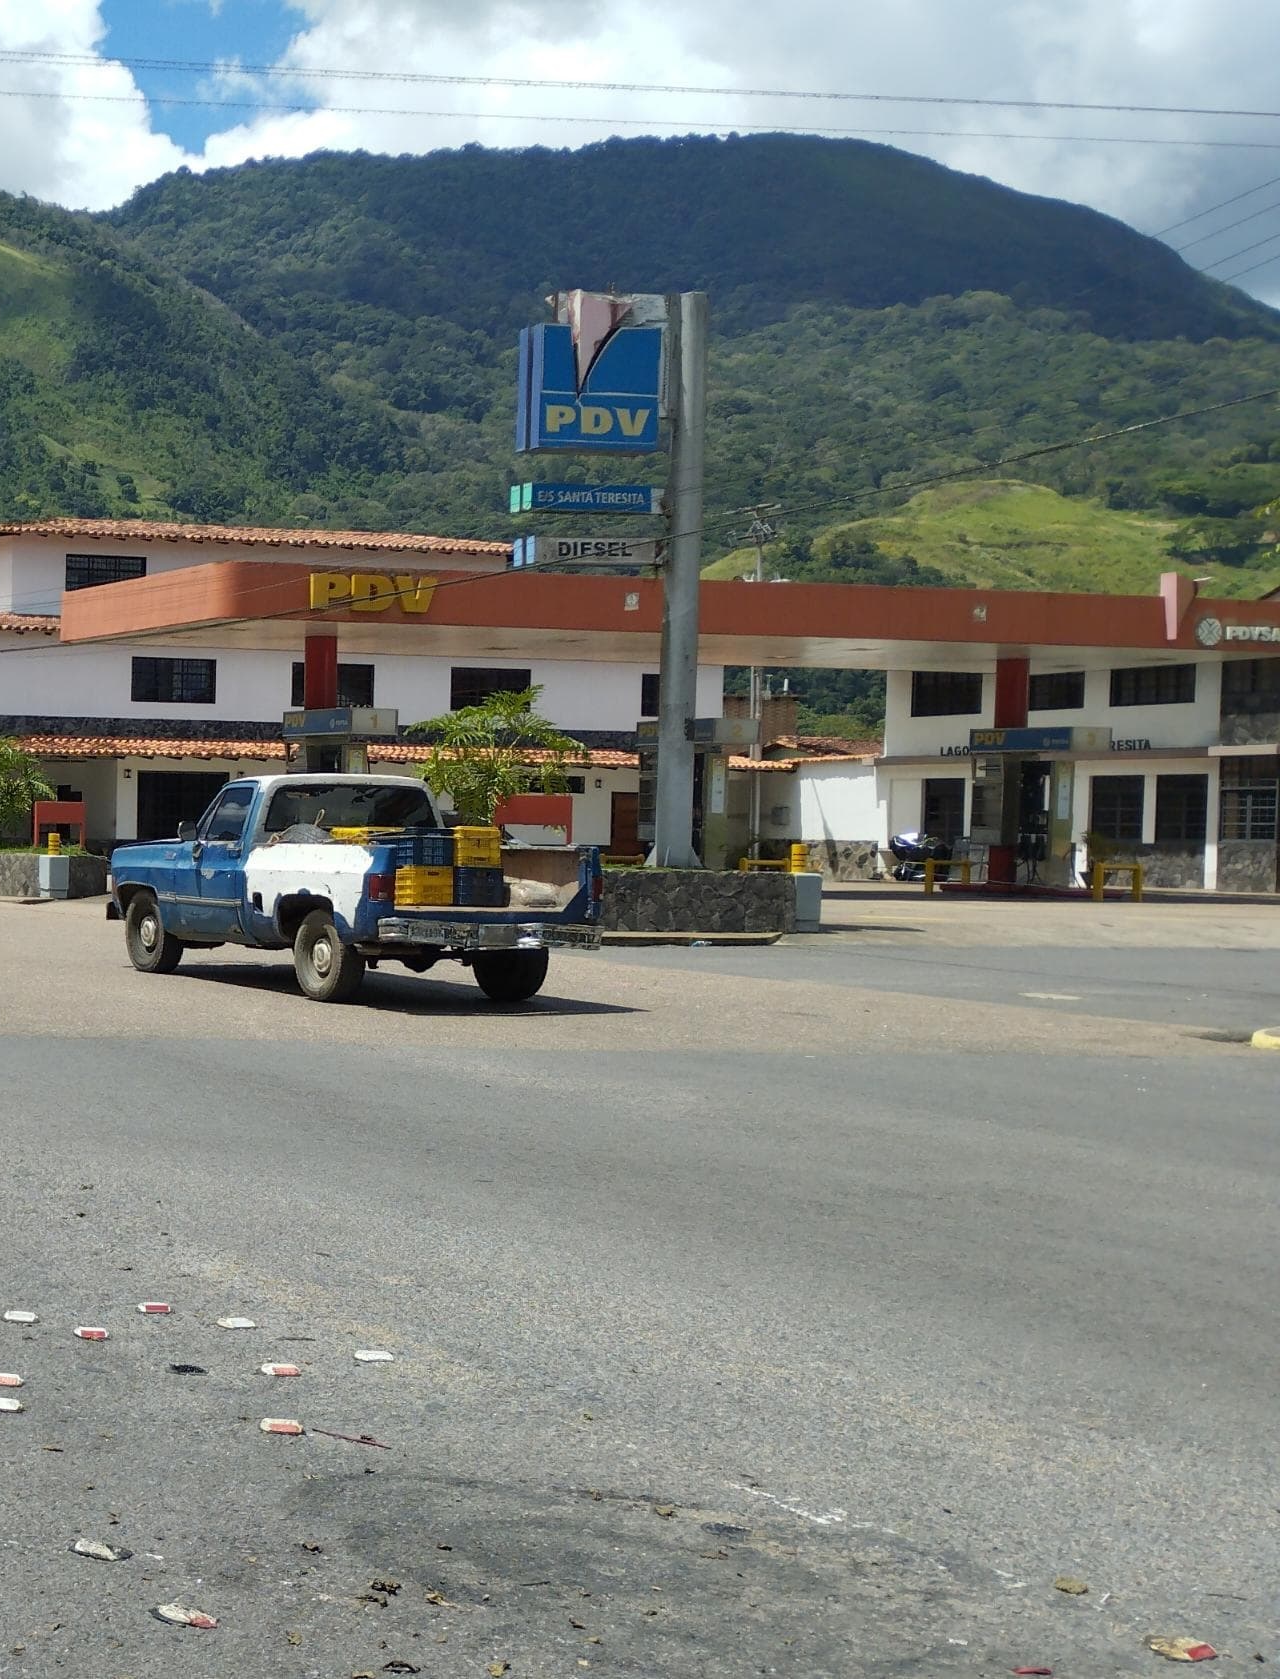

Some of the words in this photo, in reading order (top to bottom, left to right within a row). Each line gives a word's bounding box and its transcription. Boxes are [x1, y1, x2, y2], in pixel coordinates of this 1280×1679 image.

[545, 404, 651, 437] PDV
[537, 490, 555, 502] E/S
[558, 491, 593, 503] SANTA
[595, 492, 645, 504] TERESITA
[558, 541, 633, 557] DIESEL
[309, 572, 439, 613] PDV
[1226, 626, 1280, 641] PDVSA
[732, 723, 742, 736] 2
[974, 731, 1006, 746] PDV
[939, 746, 972, 757] LAGO
[1111, 739, 1152, 751] RESITA
